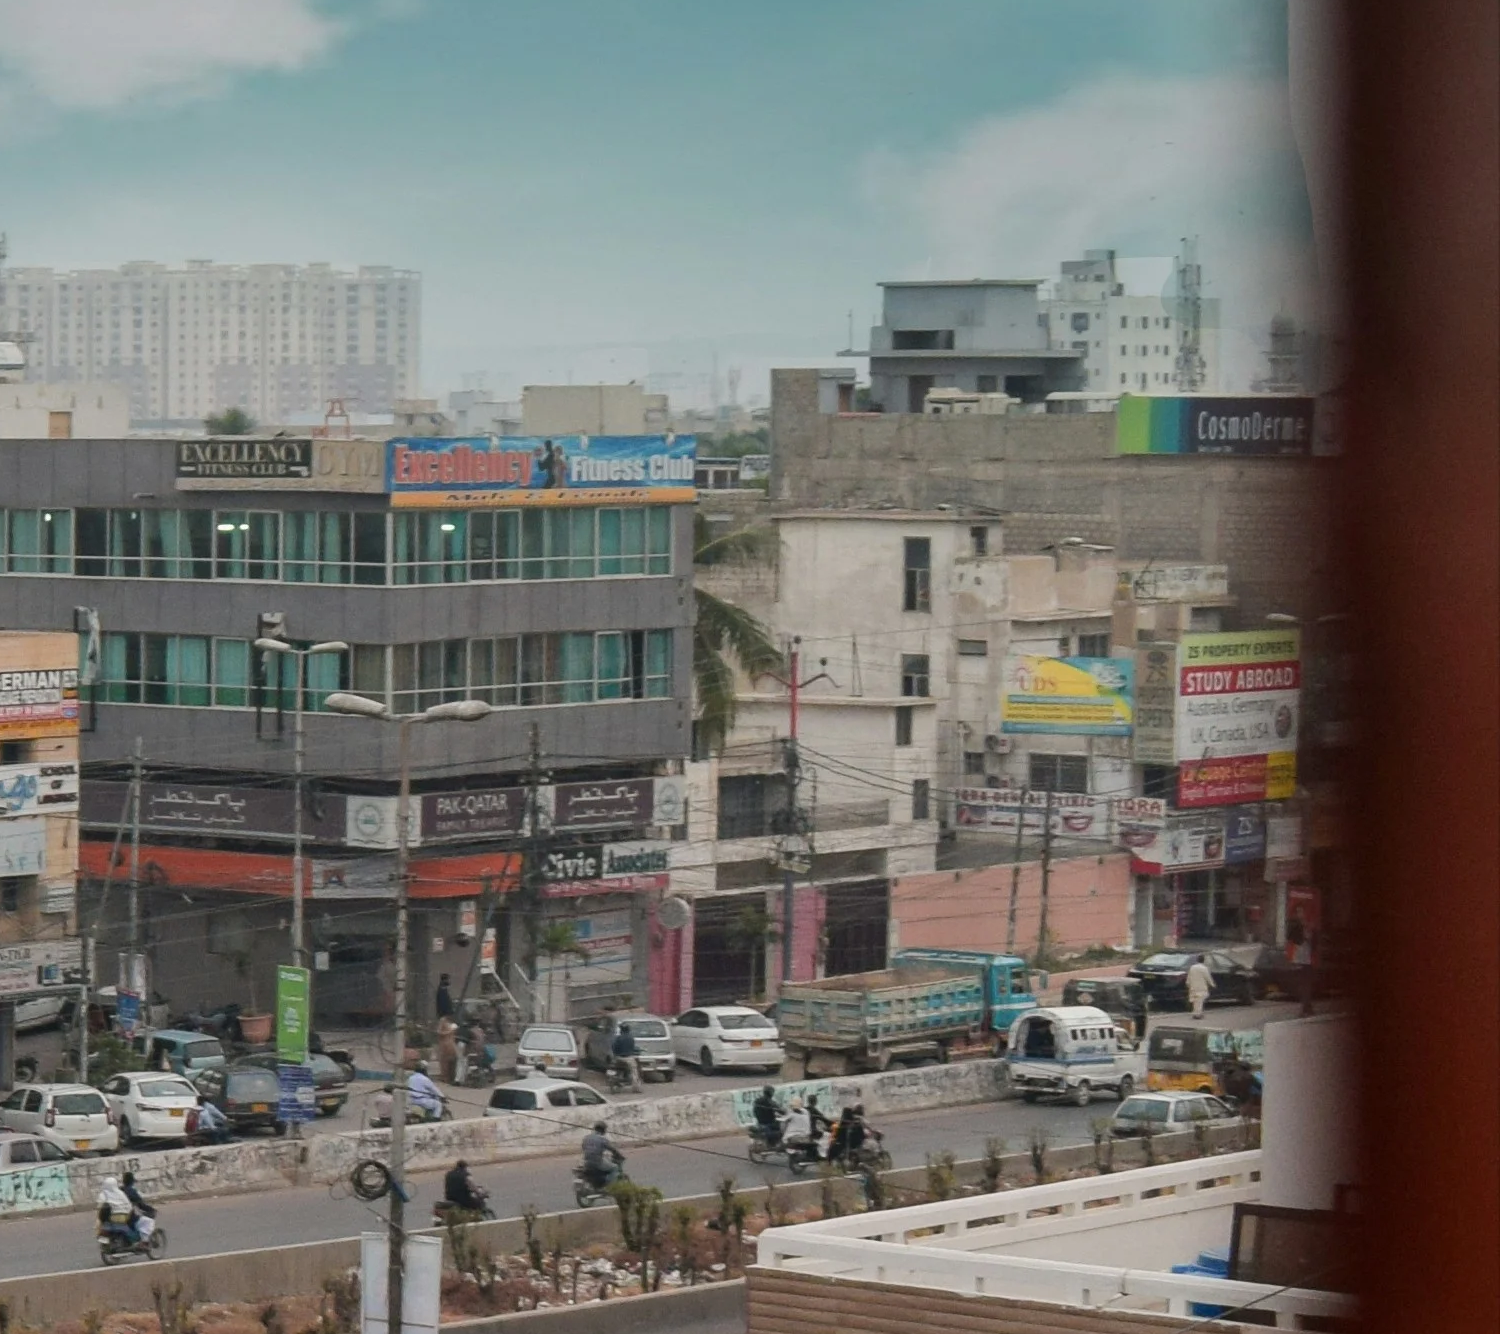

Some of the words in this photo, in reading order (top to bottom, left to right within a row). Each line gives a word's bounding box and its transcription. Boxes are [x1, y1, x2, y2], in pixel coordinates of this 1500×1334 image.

[180, 444, 303, 463] EXCELLENCY
[394, 445, 534, 485] Excellency
[570, 455, 645, 482] Fitness
[650, 448, 694, 482] Club
[1186, 671, 1231, 692] STUDY
[1236, 667, 1293, 689] ABROAD
[436, 794, 508, 815] PAK-QATAR
[543, 853, 596, 879] Civic
